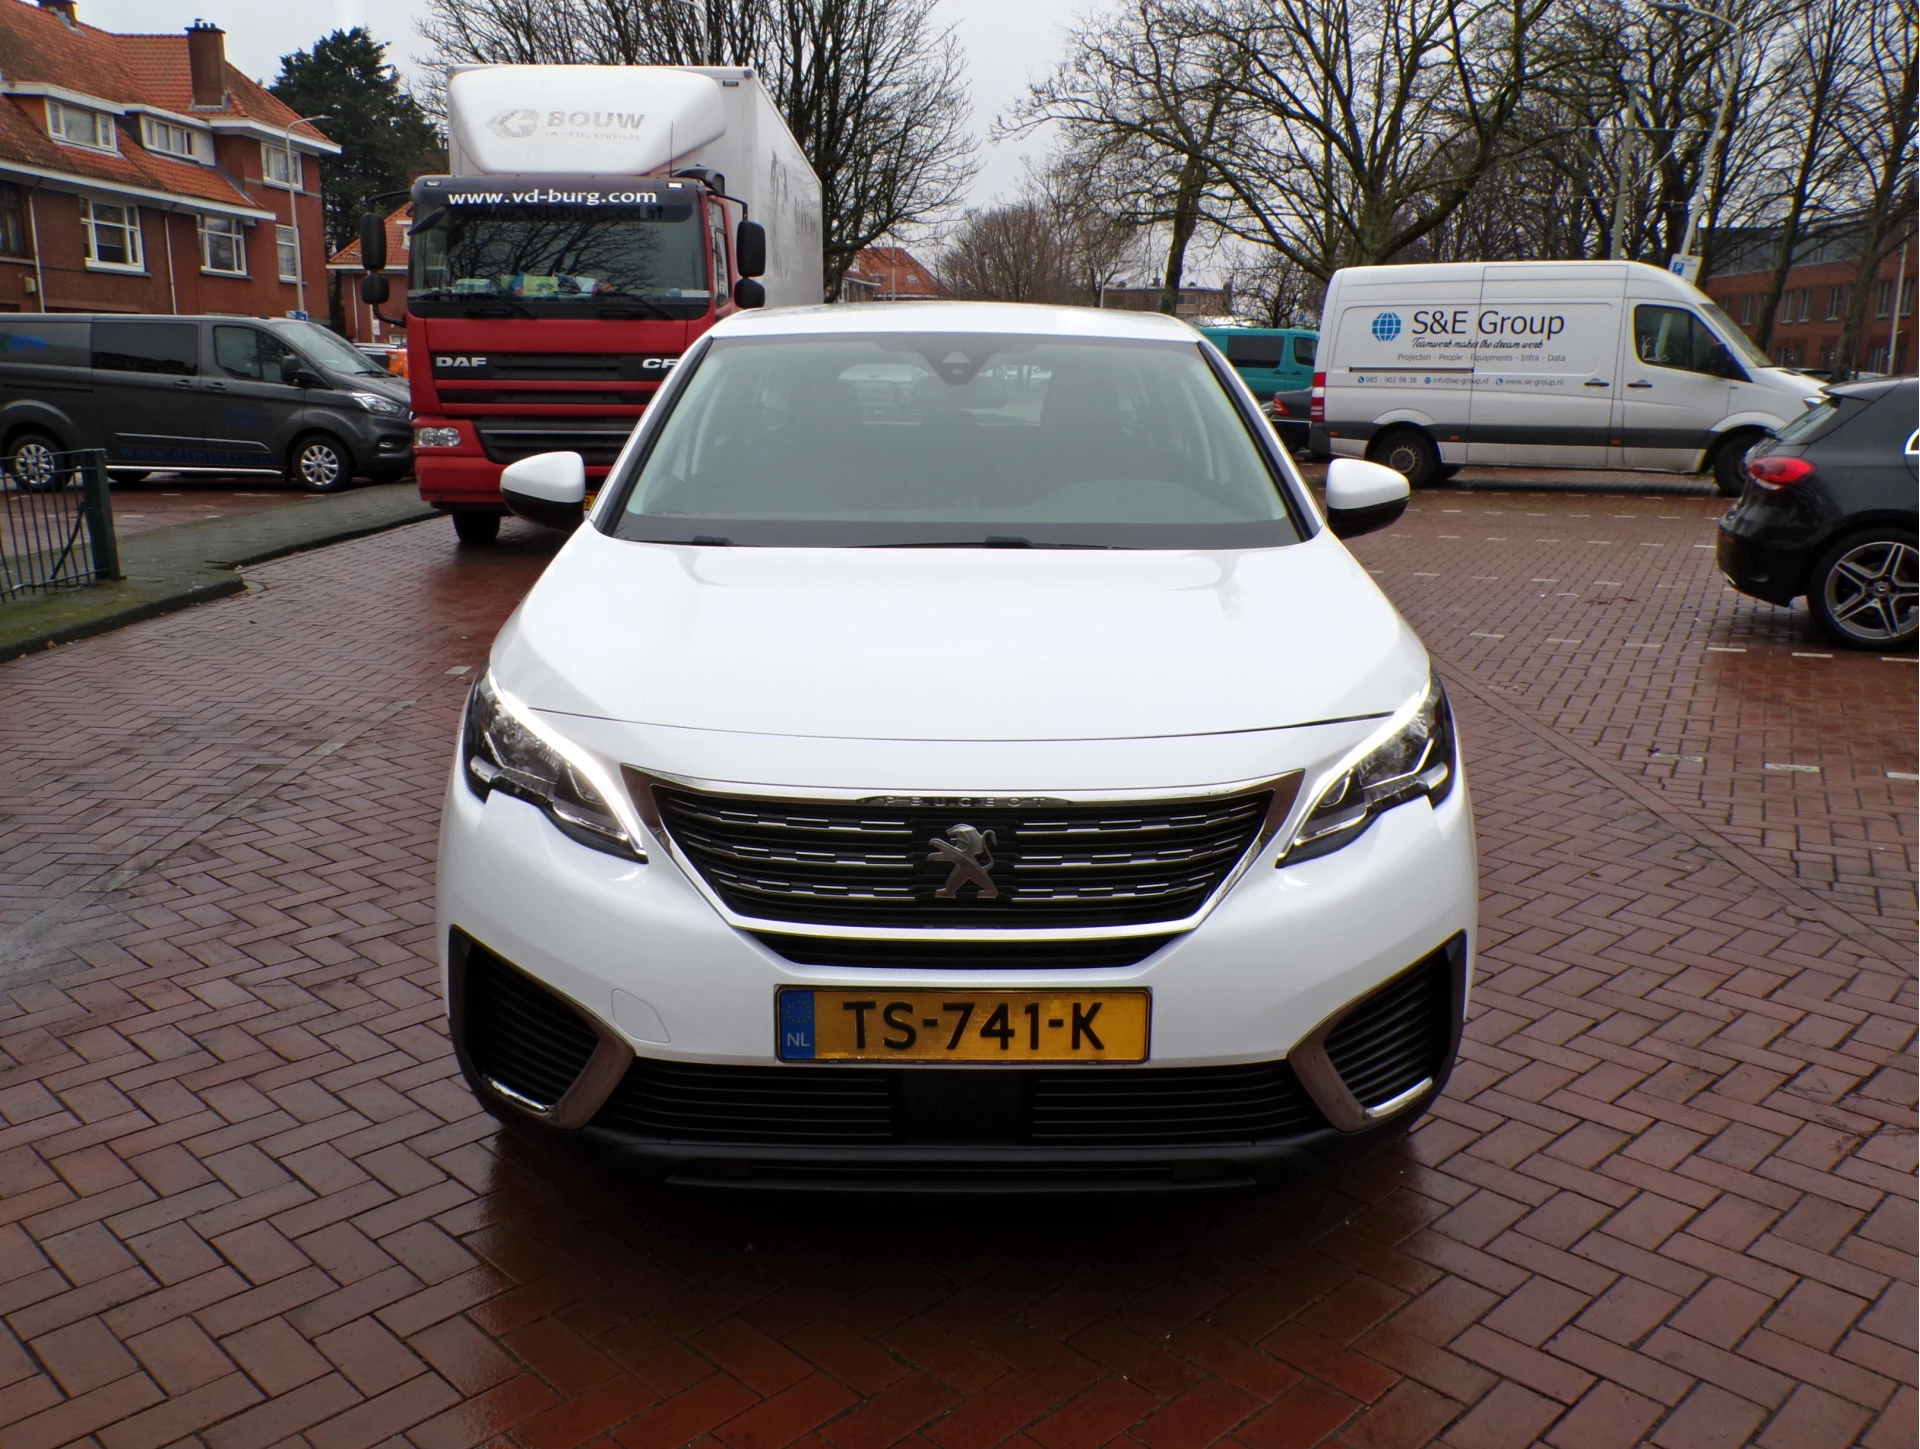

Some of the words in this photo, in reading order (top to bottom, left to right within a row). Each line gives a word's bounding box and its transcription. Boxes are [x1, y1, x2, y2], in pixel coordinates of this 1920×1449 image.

[547, 111, 645, 129] BOUW
[545, 131, 589, 139] LOISTIC
[448, 189, 657, 206] www.vd-burg.com
[1412, 310, 1469, 335] S&E
[1478, 310, 1565, 340] Group
[1412, 337, 1452, 349] Teamwork
[1479, 339, 1492, 349] the
[1493, 339, 1521, 349] dream
[1521, 339, 1543, 349] work
[436, 357, 487, 367] DAF
[1398, 353, 1432, 362] Projecten
[1438, 353, 1463, 362] People
[1470, 353, 1513, 362] Equipments
[1521, 353, 1540, 362] Infra
[1547, 354, 1566, 362] Data
[1384, 376, 1397, 384] 902
[1432, 377, 1489, 386] info@se-group.nl
[1505, 378, 1564, 387] www.se-group.nl
[884, 796, 1046, 807] PEUGEOT
[842, 1001, 1105, 1050] TS-741-K
[787, 1032, 810, 1047] NL
